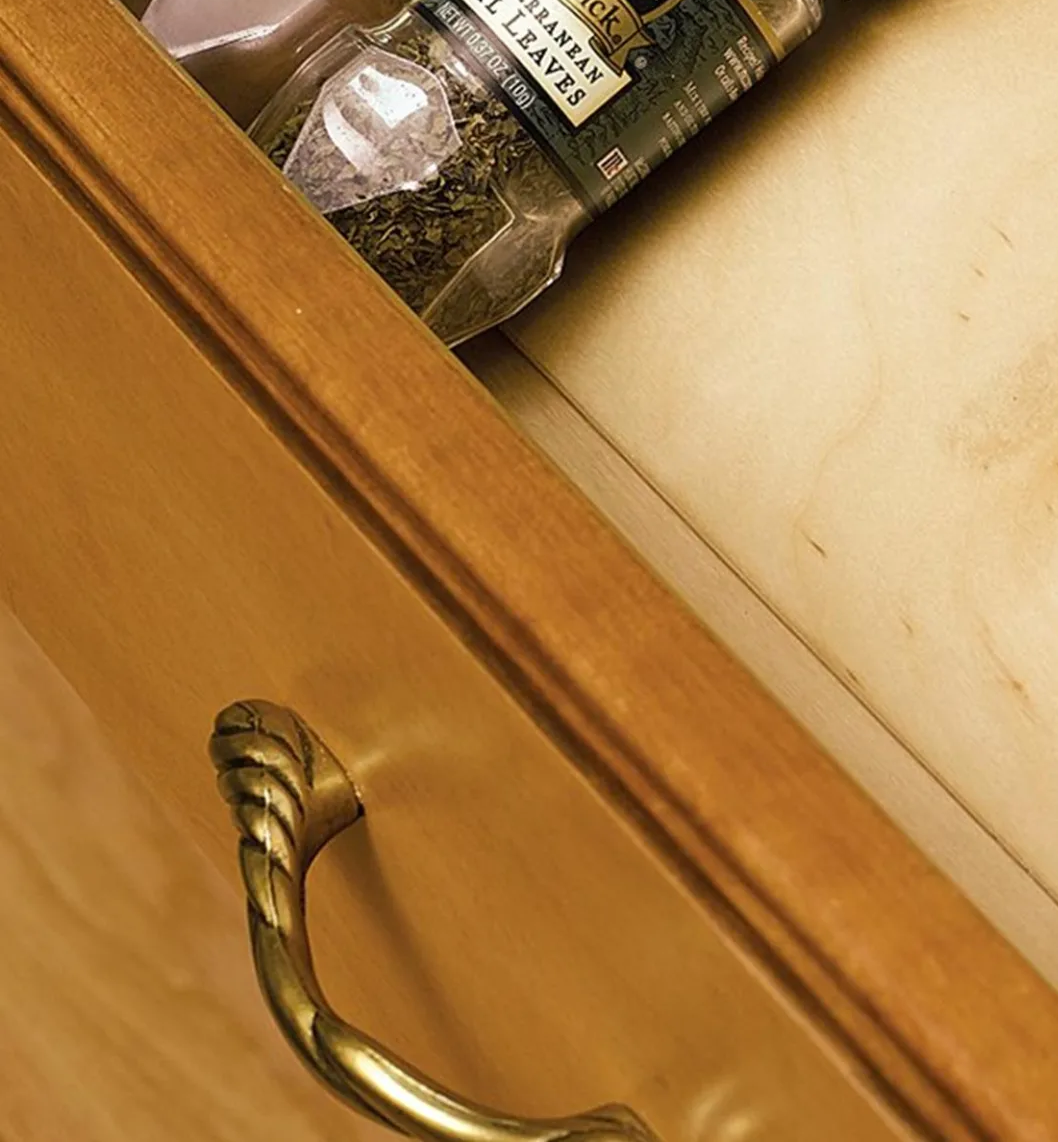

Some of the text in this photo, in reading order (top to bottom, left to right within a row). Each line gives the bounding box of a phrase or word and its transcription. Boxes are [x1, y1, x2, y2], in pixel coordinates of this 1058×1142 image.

[486, 54, 508, 76] OZ
[499, 72, 537, 110] (10g)
[500, 8, 587, 108] LEAVES
